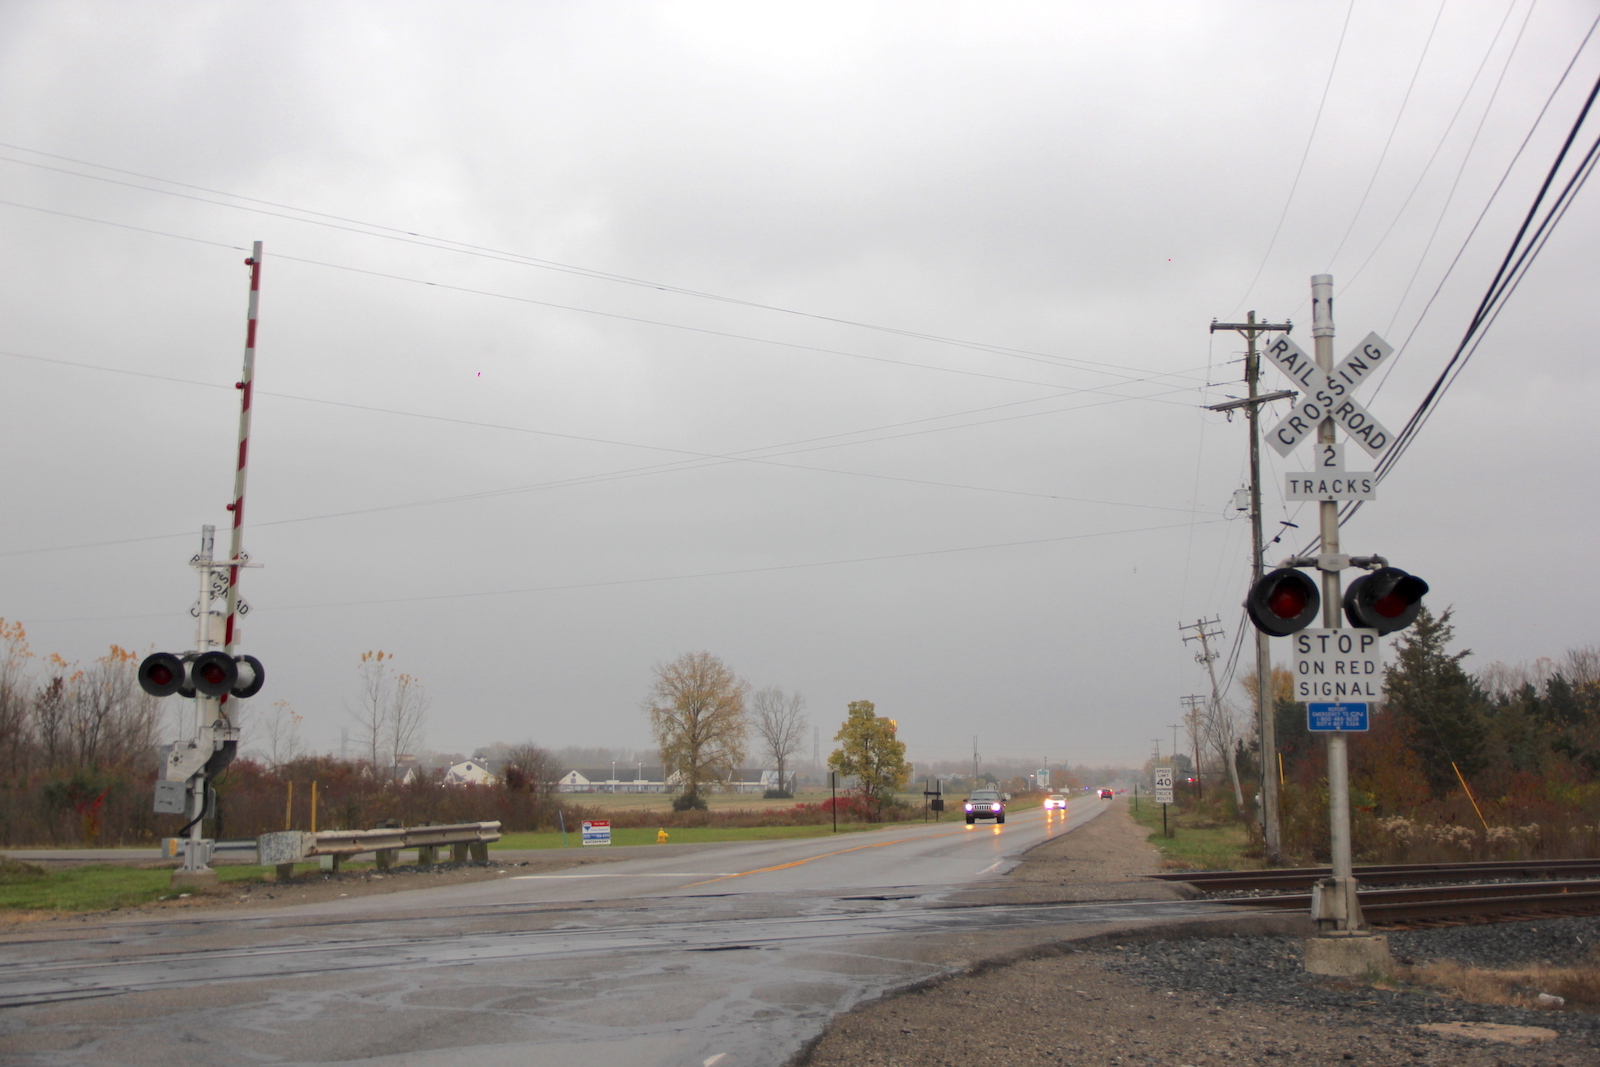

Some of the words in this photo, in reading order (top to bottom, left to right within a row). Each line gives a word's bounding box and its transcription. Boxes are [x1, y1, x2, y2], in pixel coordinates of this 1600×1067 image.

[1269, 339, 1315, 388] RAIL
[1335, 401, 1386, 450] ROAD
[1277, 343, 1382, 445] CROSSING
[1323, 448, 1336, 467] 2
[1290, 479, 1371, 494] TRACKS
[1298, 634, 1374, 654] STOP
[1299, 661, 1324, 675] ON
[1335, 661, 1375, 675] RED
[1300, 681, 1375, 696] SIGNAL
[1156, 778, 1172, 787] 40
